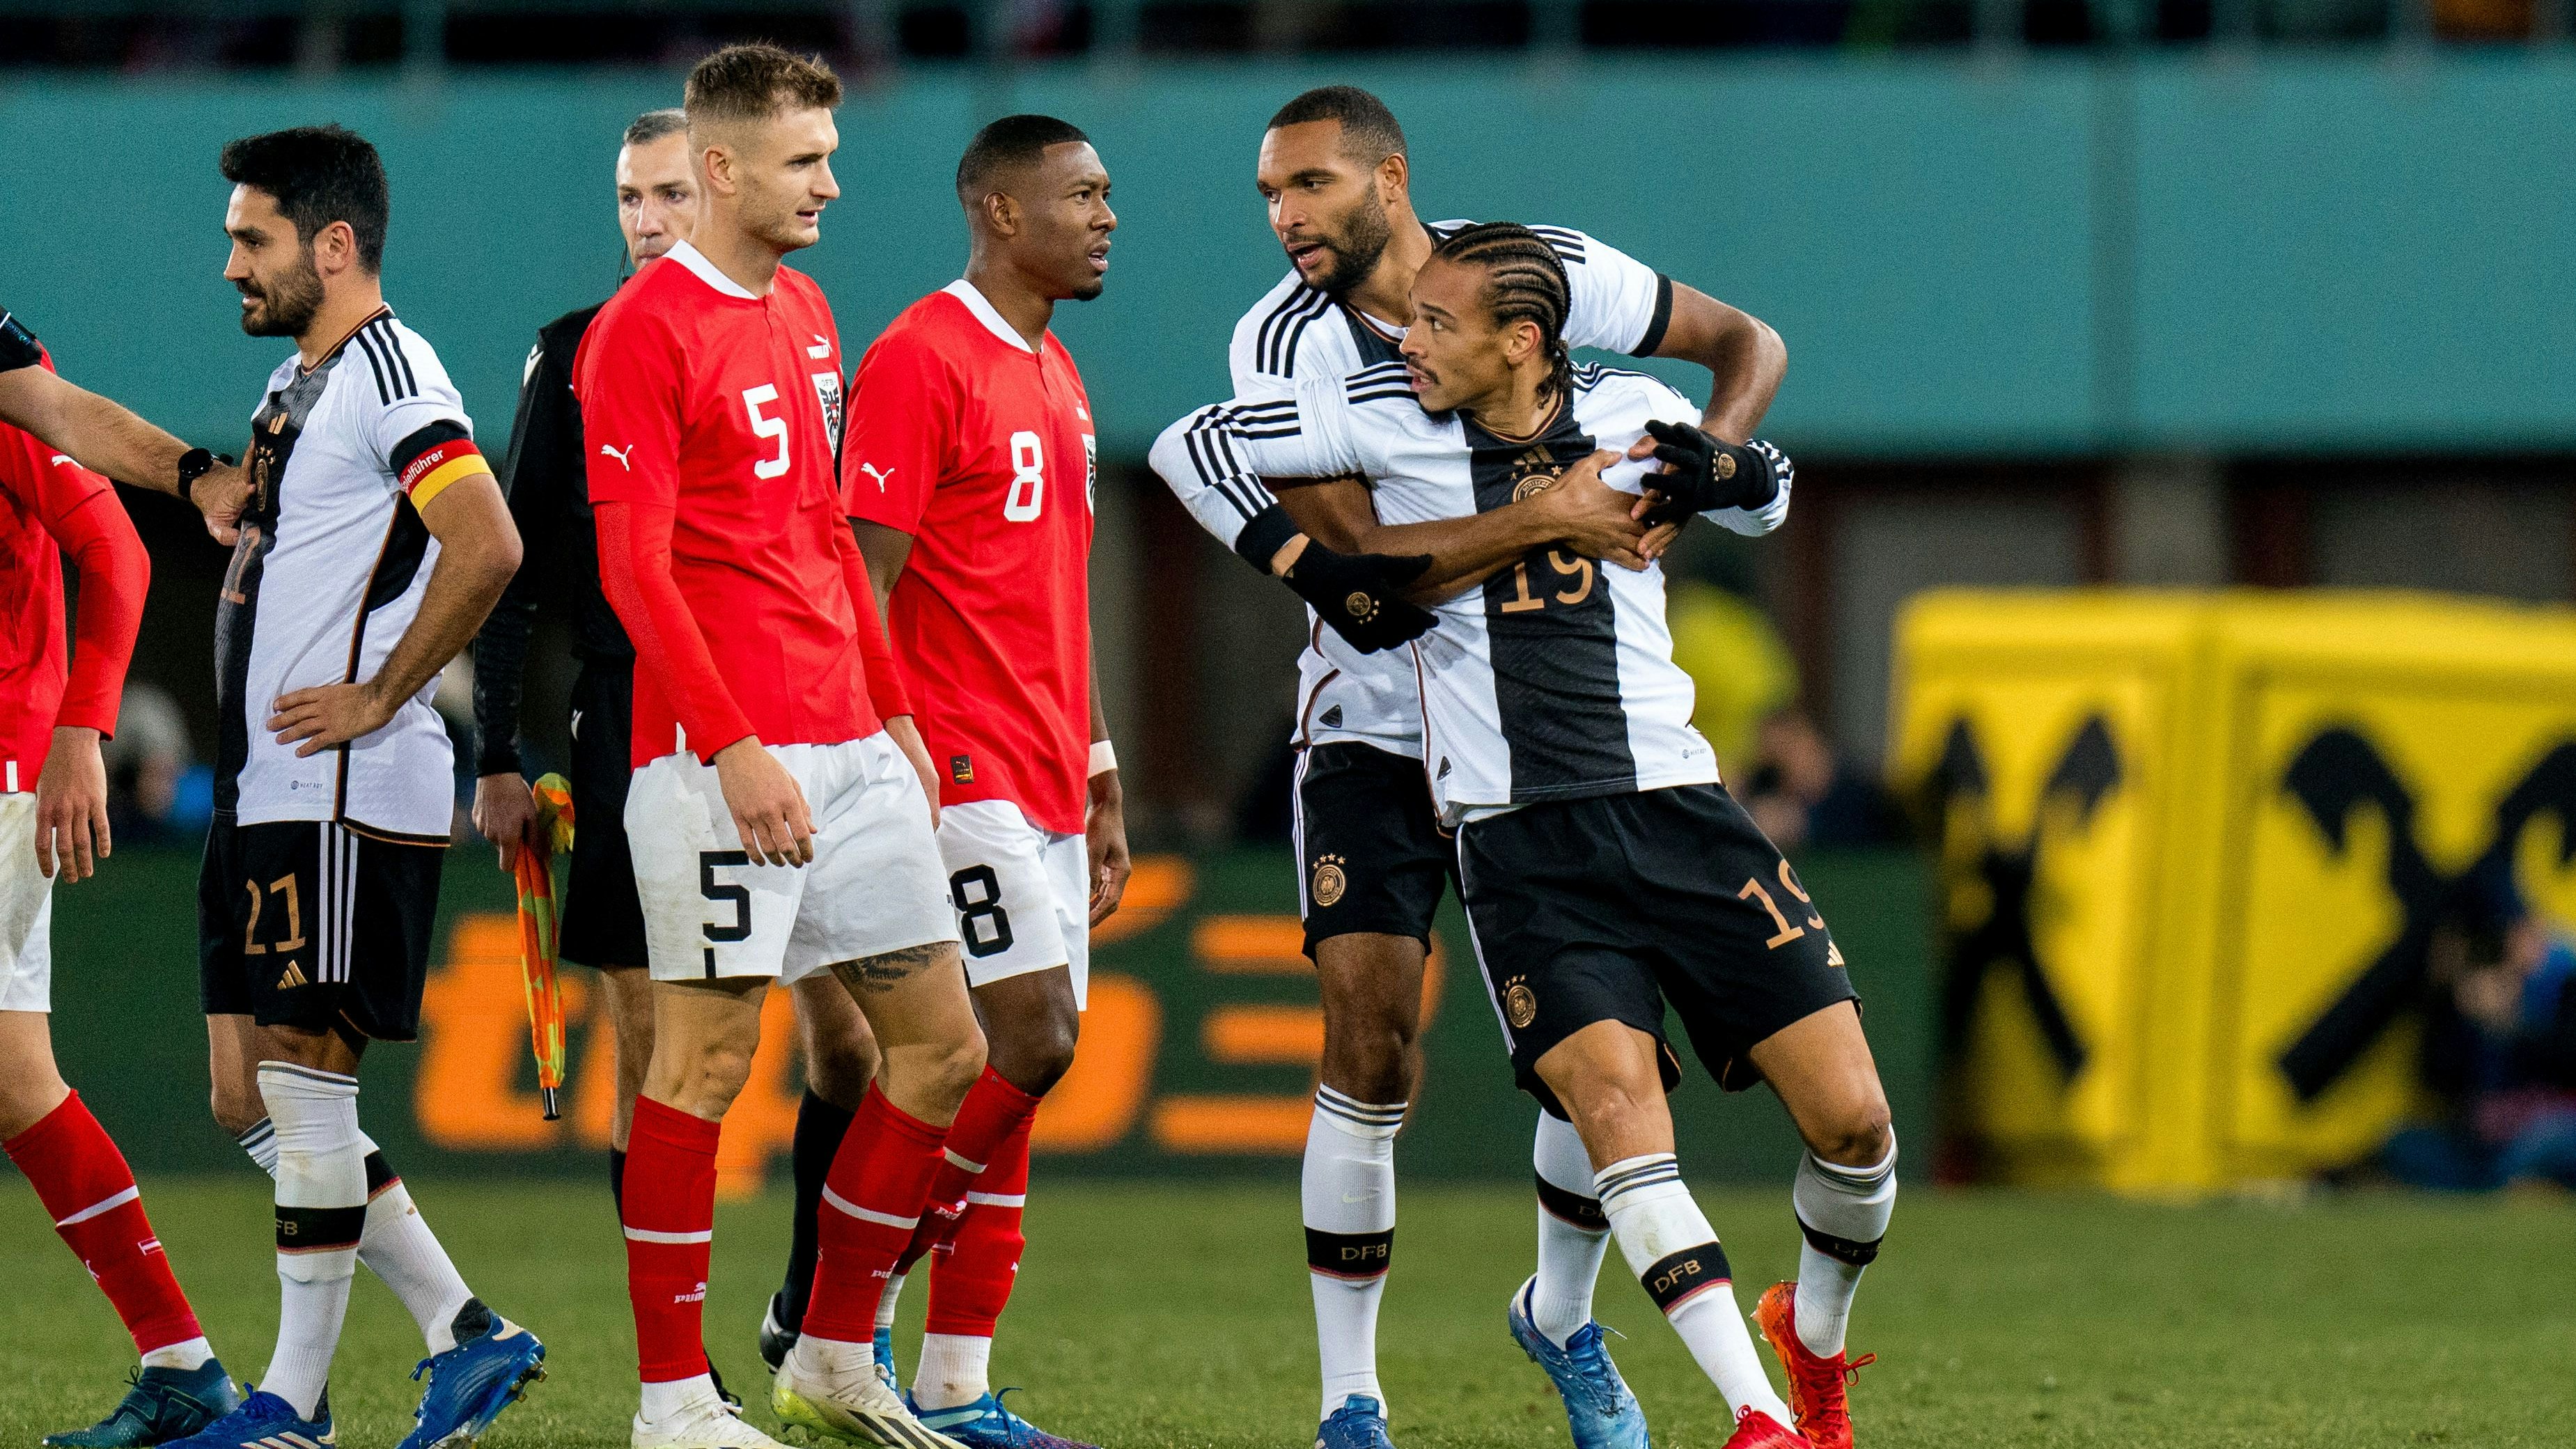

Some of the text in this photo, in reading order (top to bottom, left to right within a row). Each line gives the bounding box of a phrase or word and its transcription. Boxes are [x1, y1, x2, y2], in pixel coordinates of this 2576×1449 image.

[742, 383, 791, 480] 5
[1004, 431, 1044, 522] 8
[1501, 551, 1593, 613] 19
[245, 872, 306, 954] 21
[699, 851, 751, 941] 5
[949, 864, 1014, 959] 8
[1341, 1244, 1387, 1260] DFB
[1654, 1260, 1702, 1294] DFB
